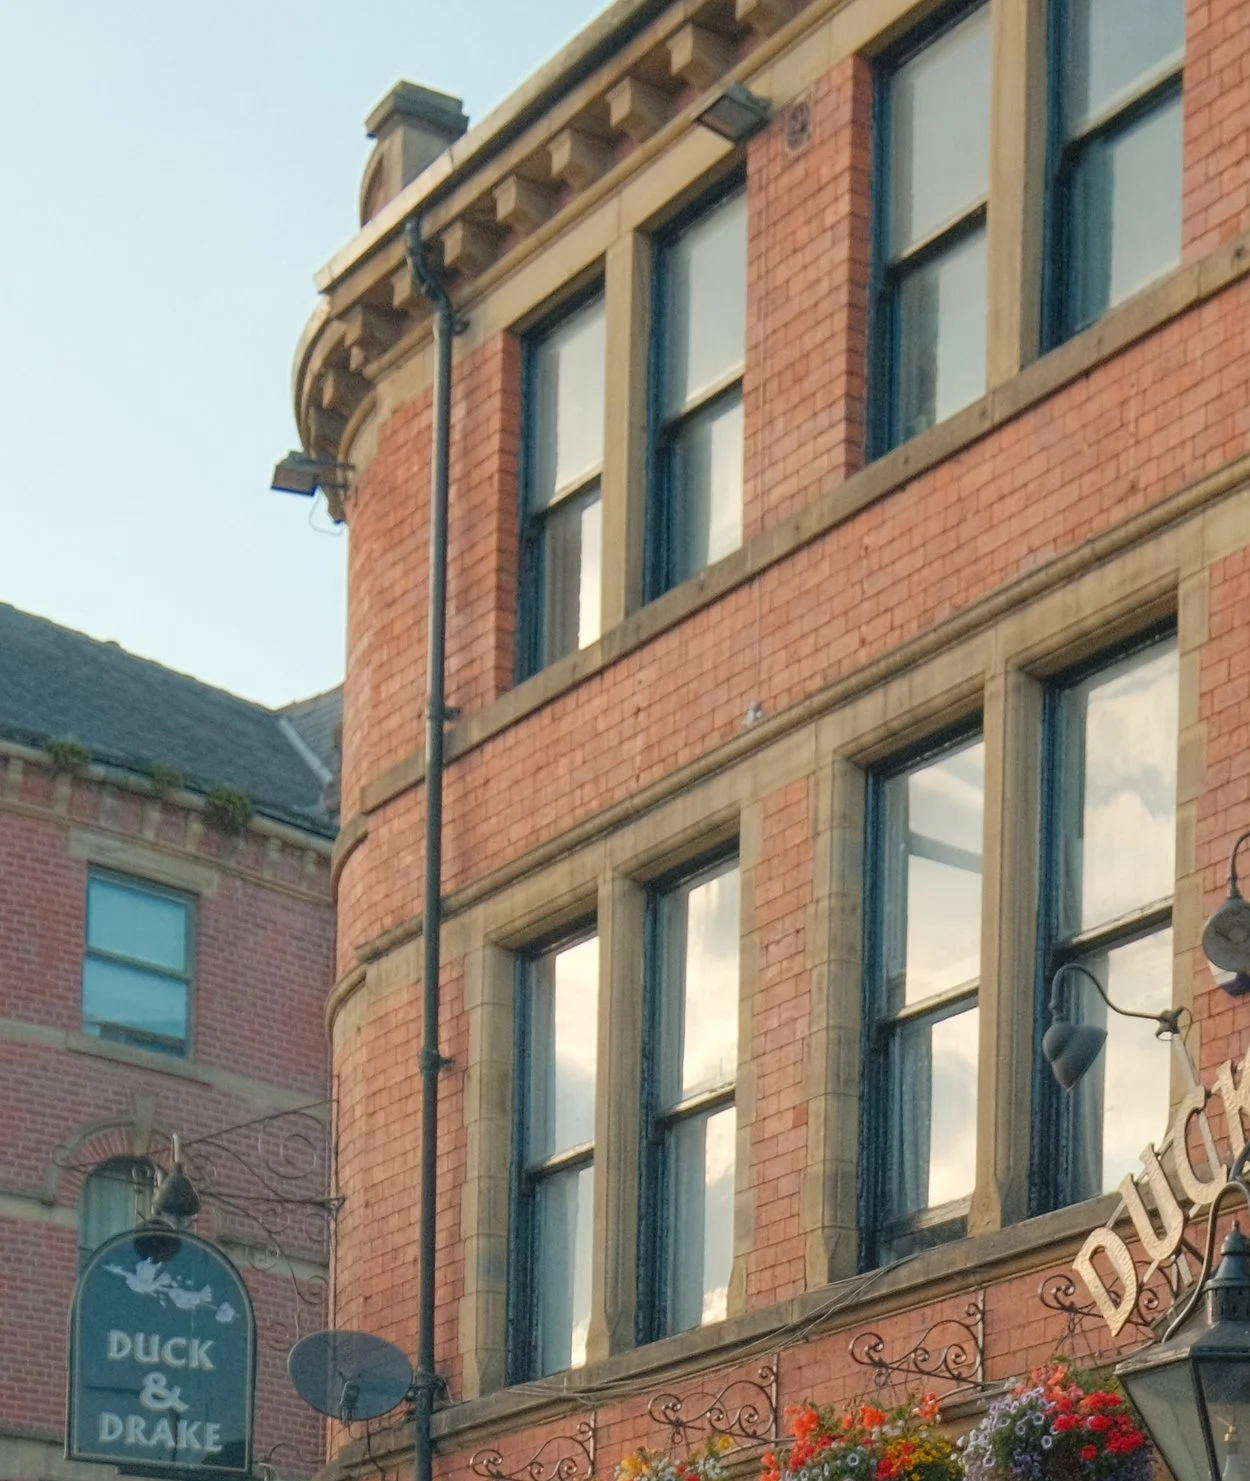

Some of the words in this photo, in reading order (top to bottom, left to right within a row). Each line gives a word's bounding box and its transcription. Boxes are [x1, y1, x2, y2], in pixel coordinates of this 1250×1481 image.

[106, 1328, 215, 1371] DUCK
[139, 1371, 189, 1413] &
[99, 1411, 224, 1453] DRAKE
